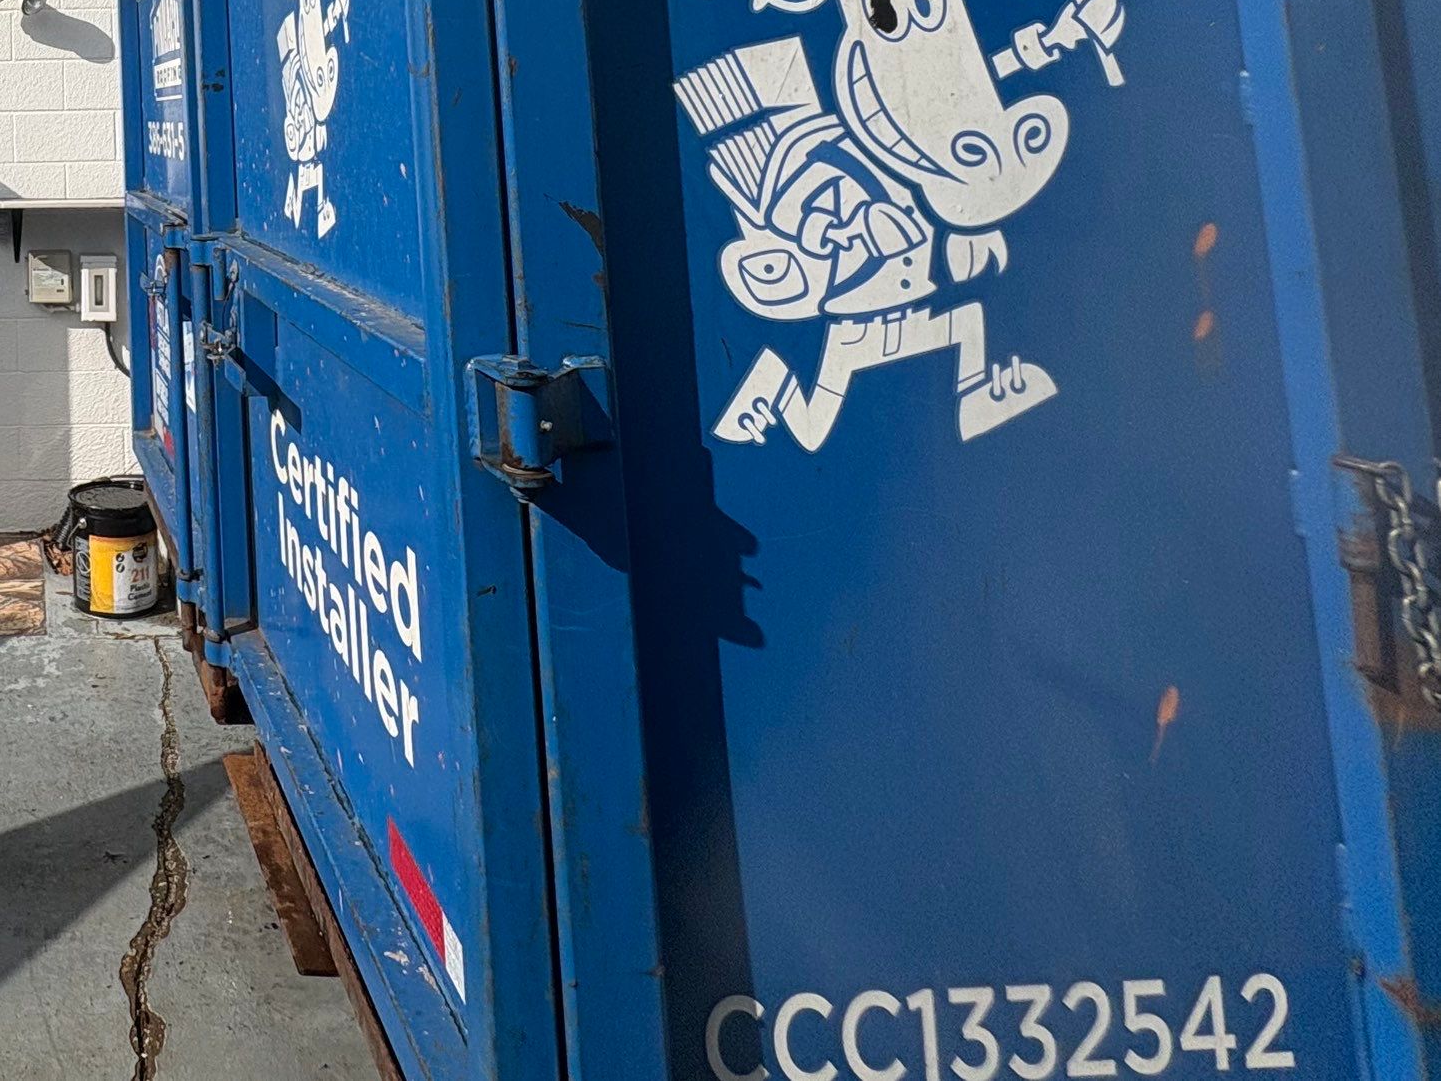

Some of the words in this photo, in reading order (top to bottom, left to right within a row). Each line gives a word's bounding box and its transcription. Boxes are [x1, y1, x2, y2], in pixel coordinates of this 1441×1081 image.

[131, 566, 149, 583] 211
[270, 409, 421, 662] Certified
[278, 491, 419, 768] Installer
[705, 973, 1296, 1081] CCC1332542
